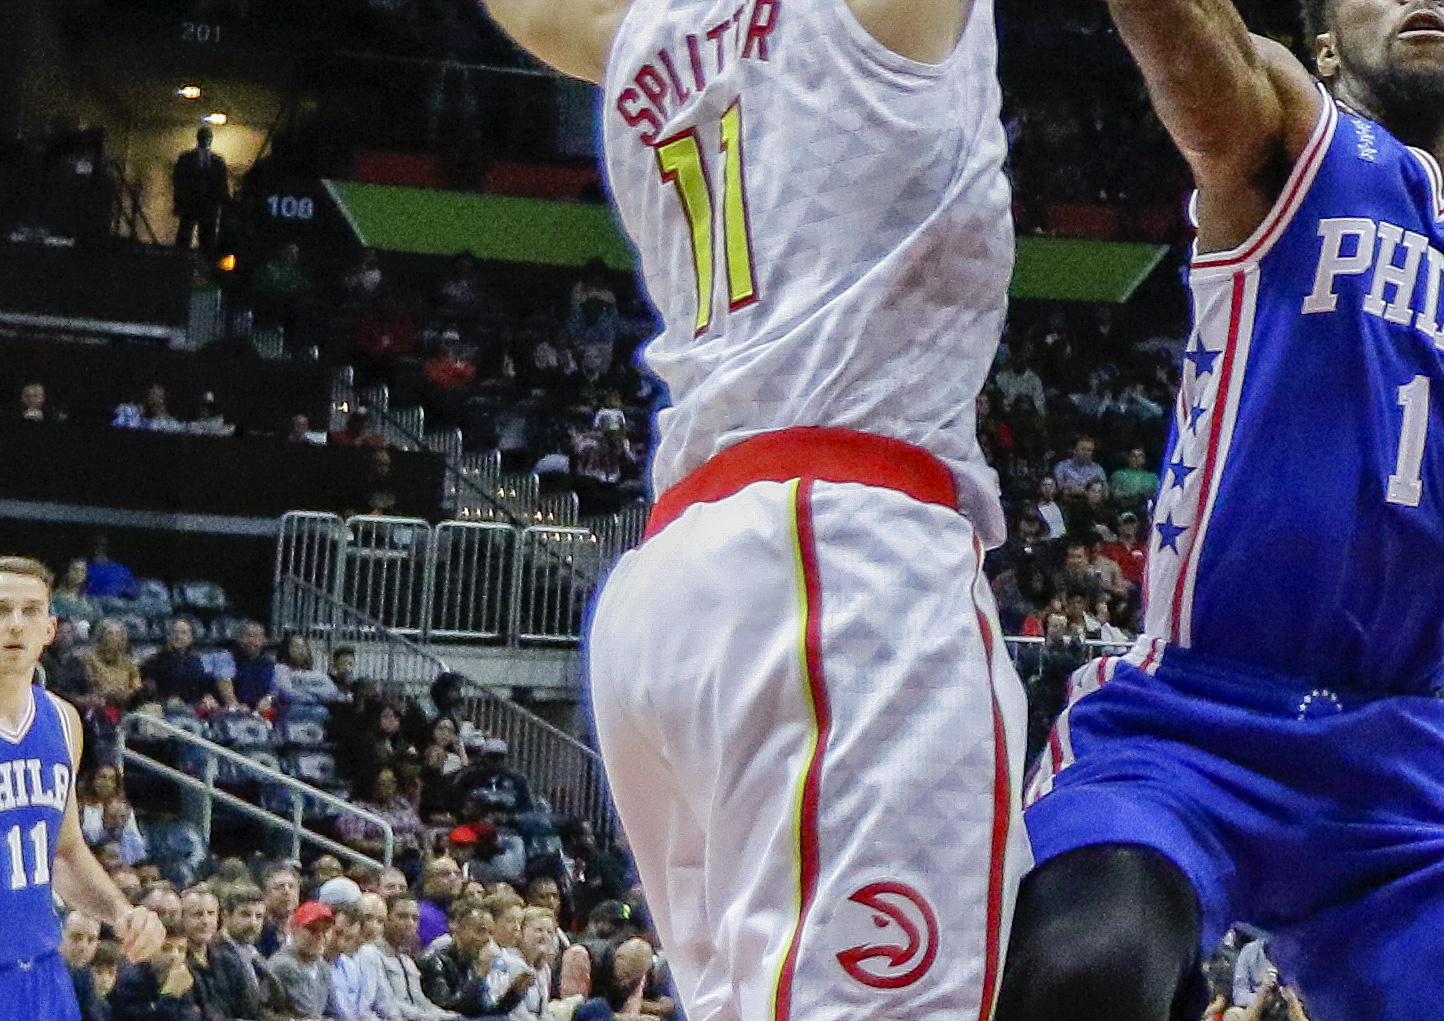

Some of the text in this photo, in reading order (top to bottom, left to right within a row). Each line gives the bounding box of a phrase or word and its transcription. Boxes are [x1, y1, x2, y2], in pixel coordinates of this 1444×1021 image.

[654, 93, 760, 339] 11
[1385, 374, 1431, 508] 1
[7, 819, 51, 891] 11
